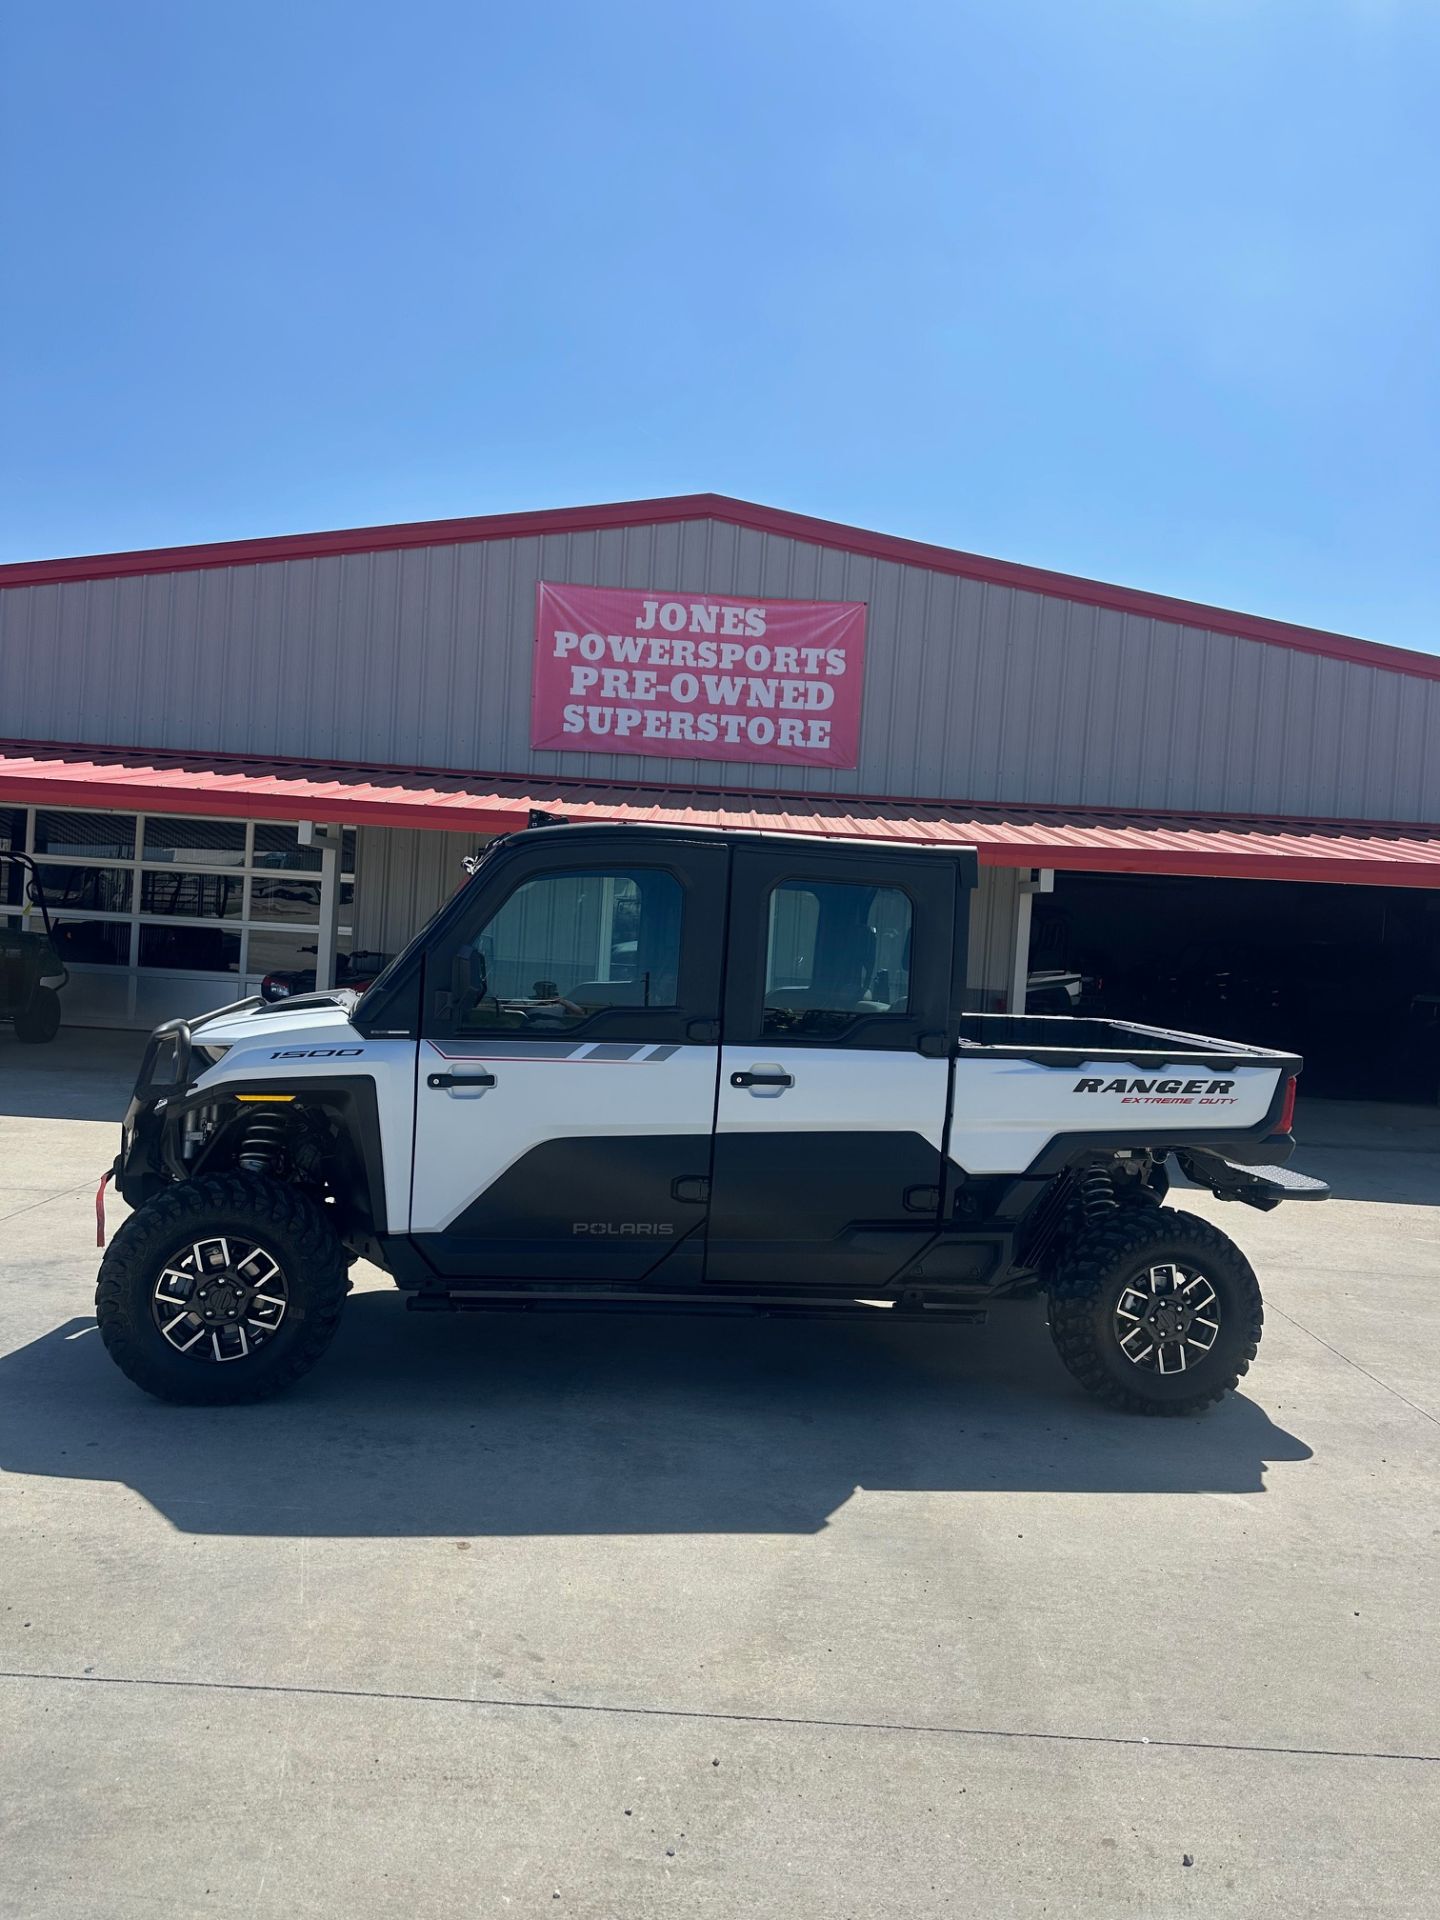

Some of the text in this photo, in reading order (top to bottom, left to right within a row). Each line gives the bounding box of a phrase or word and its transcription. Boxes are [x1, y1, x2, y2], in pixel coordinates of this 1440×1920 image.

[635, 601, 767, 637] JONES
[553, 631, 847, 676] POWERSPORTS
[569, 665, 835, 711] PRE-OWNED
[562, 704, 832, 749] SUPERSTORE
[270, 1048, 364, 1060] 1500
[1072, 1079, 1236, 1095] RANGER
[1120, 1097, 1239, 1106] EXTREME DUTY
[572, 1222, 675, 1236] POLARIS
